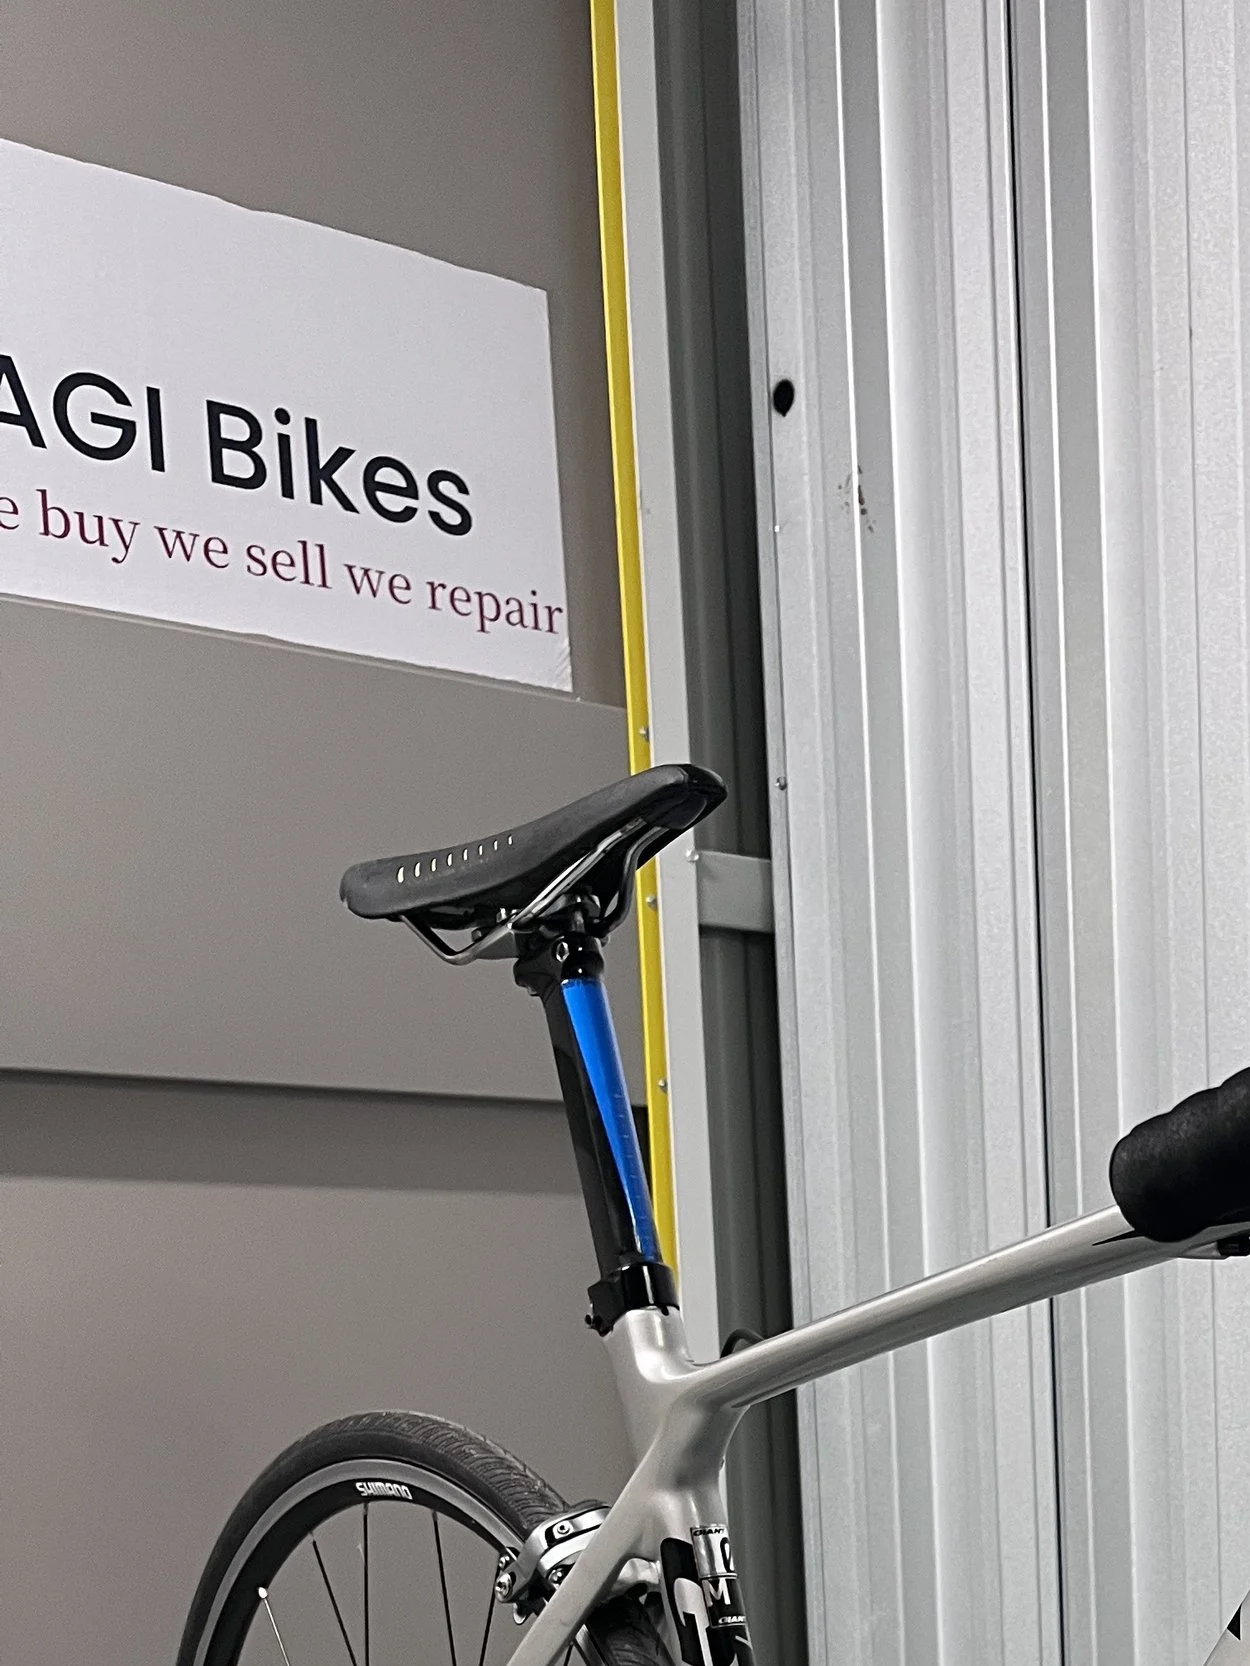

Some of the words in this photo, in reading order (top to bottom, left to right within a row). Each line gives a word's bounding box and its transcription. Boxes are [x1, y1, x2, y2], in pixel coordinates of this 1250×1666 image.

[206, 400, 472, 536] Bikes
[0, 497, 19, 529] e
[36, 489, 140, 563] buy
[154, 525, 229, 568] we
[246, 540, 332, 589] sell
[343, 563, 412, 604] we
[426, 580, 563, 634] repair
[355, 1481, 413, 1500] SHIMANO
[702, 1578, 731, 1607] M
